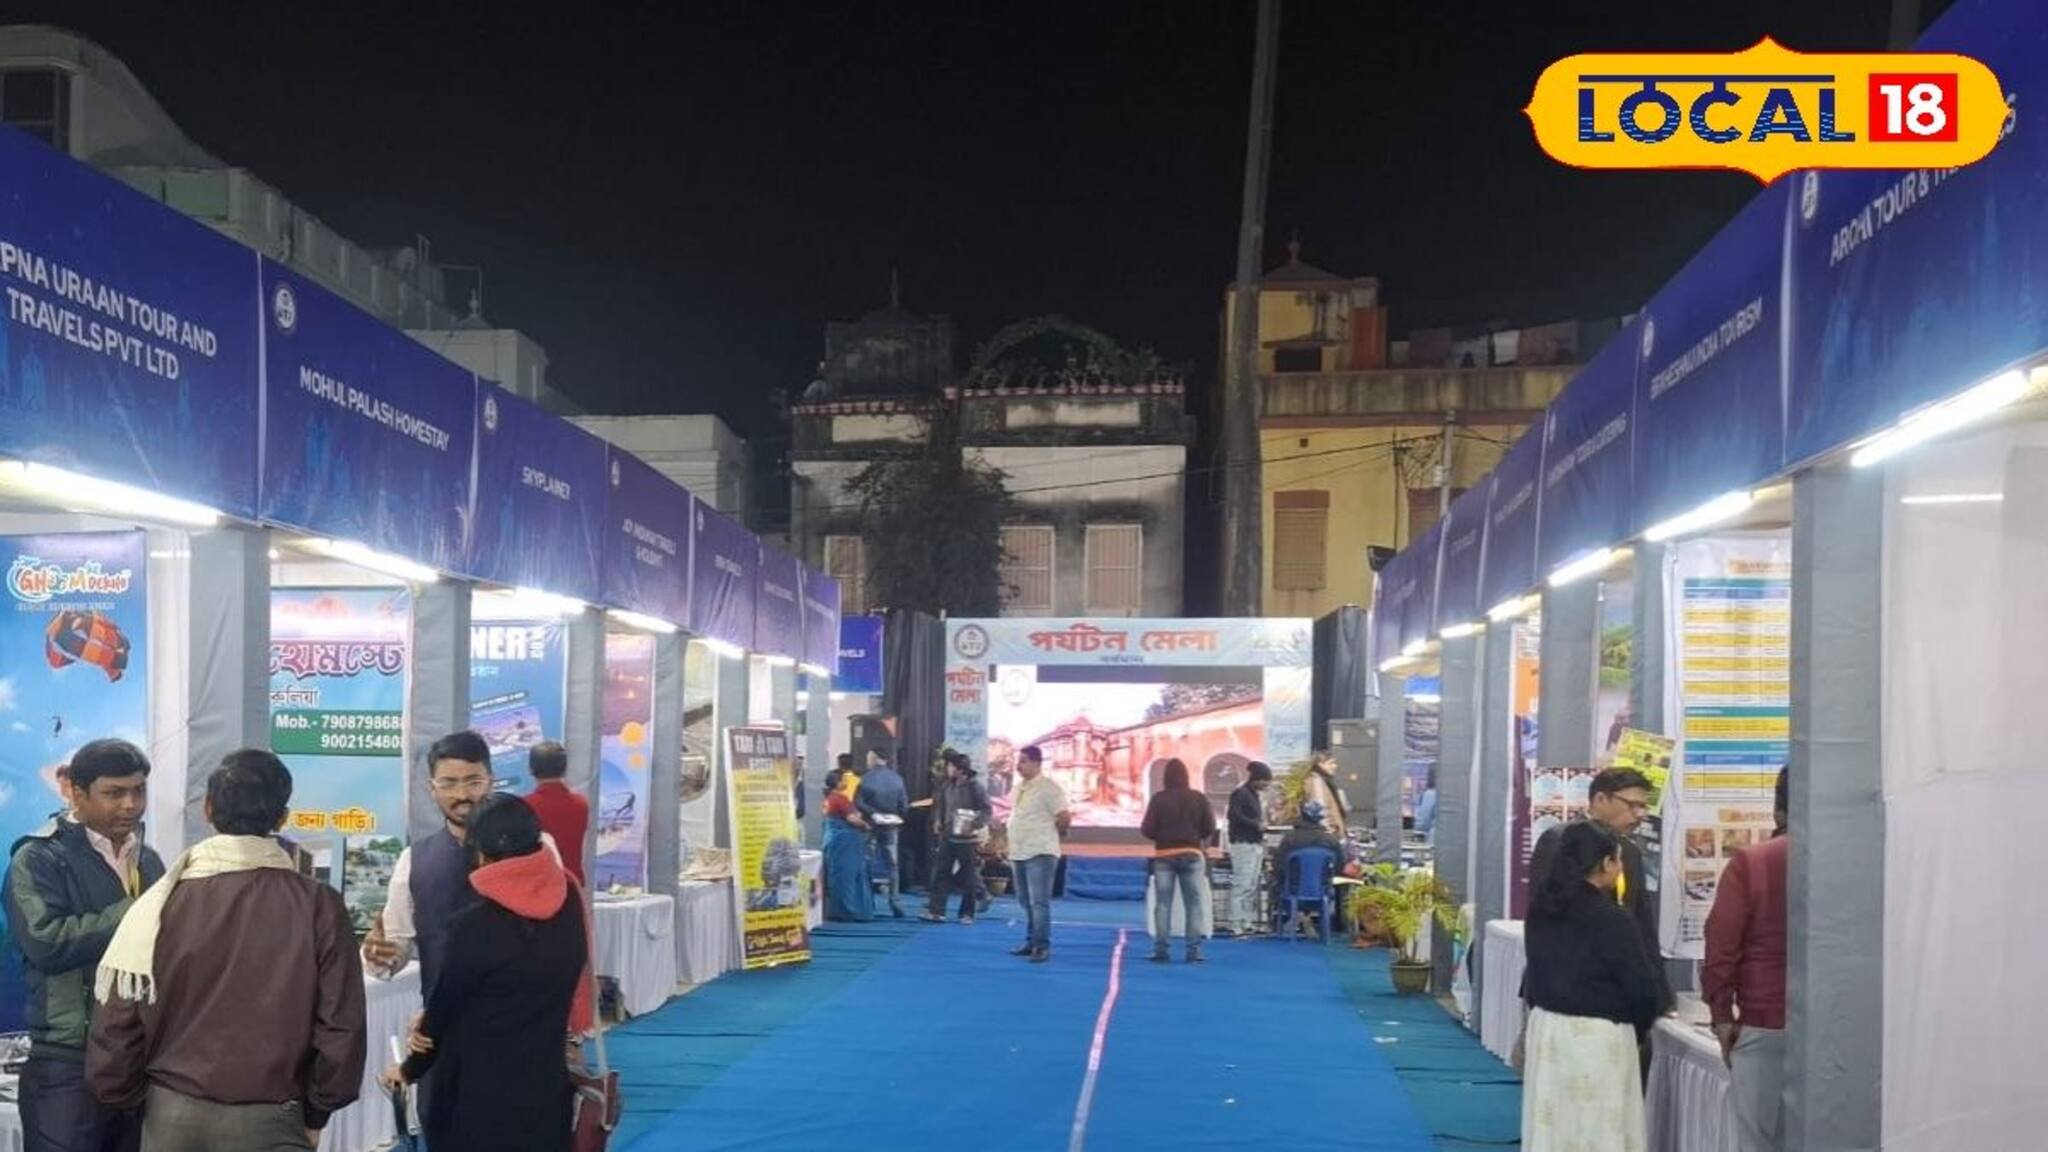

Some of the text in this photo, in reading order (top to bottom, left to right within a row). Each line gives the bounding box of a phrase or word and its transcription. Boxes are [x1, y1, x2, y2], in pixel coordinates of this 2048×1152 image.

[1873, 172, 1917, 229] TOUR
[0, 242, 217, 356] PNA URAAN TOUR AND
[7, 287, 178, 379] TRAVELS PVT LTD
[300, 366, 450, 451] MOHUL PALASH HOMESTAY
[470, 626, 527, 660] NER
[1028, 622, 1219, 652] পর্যটন মেলা
[275, 714, 318, 729] Mob.-
